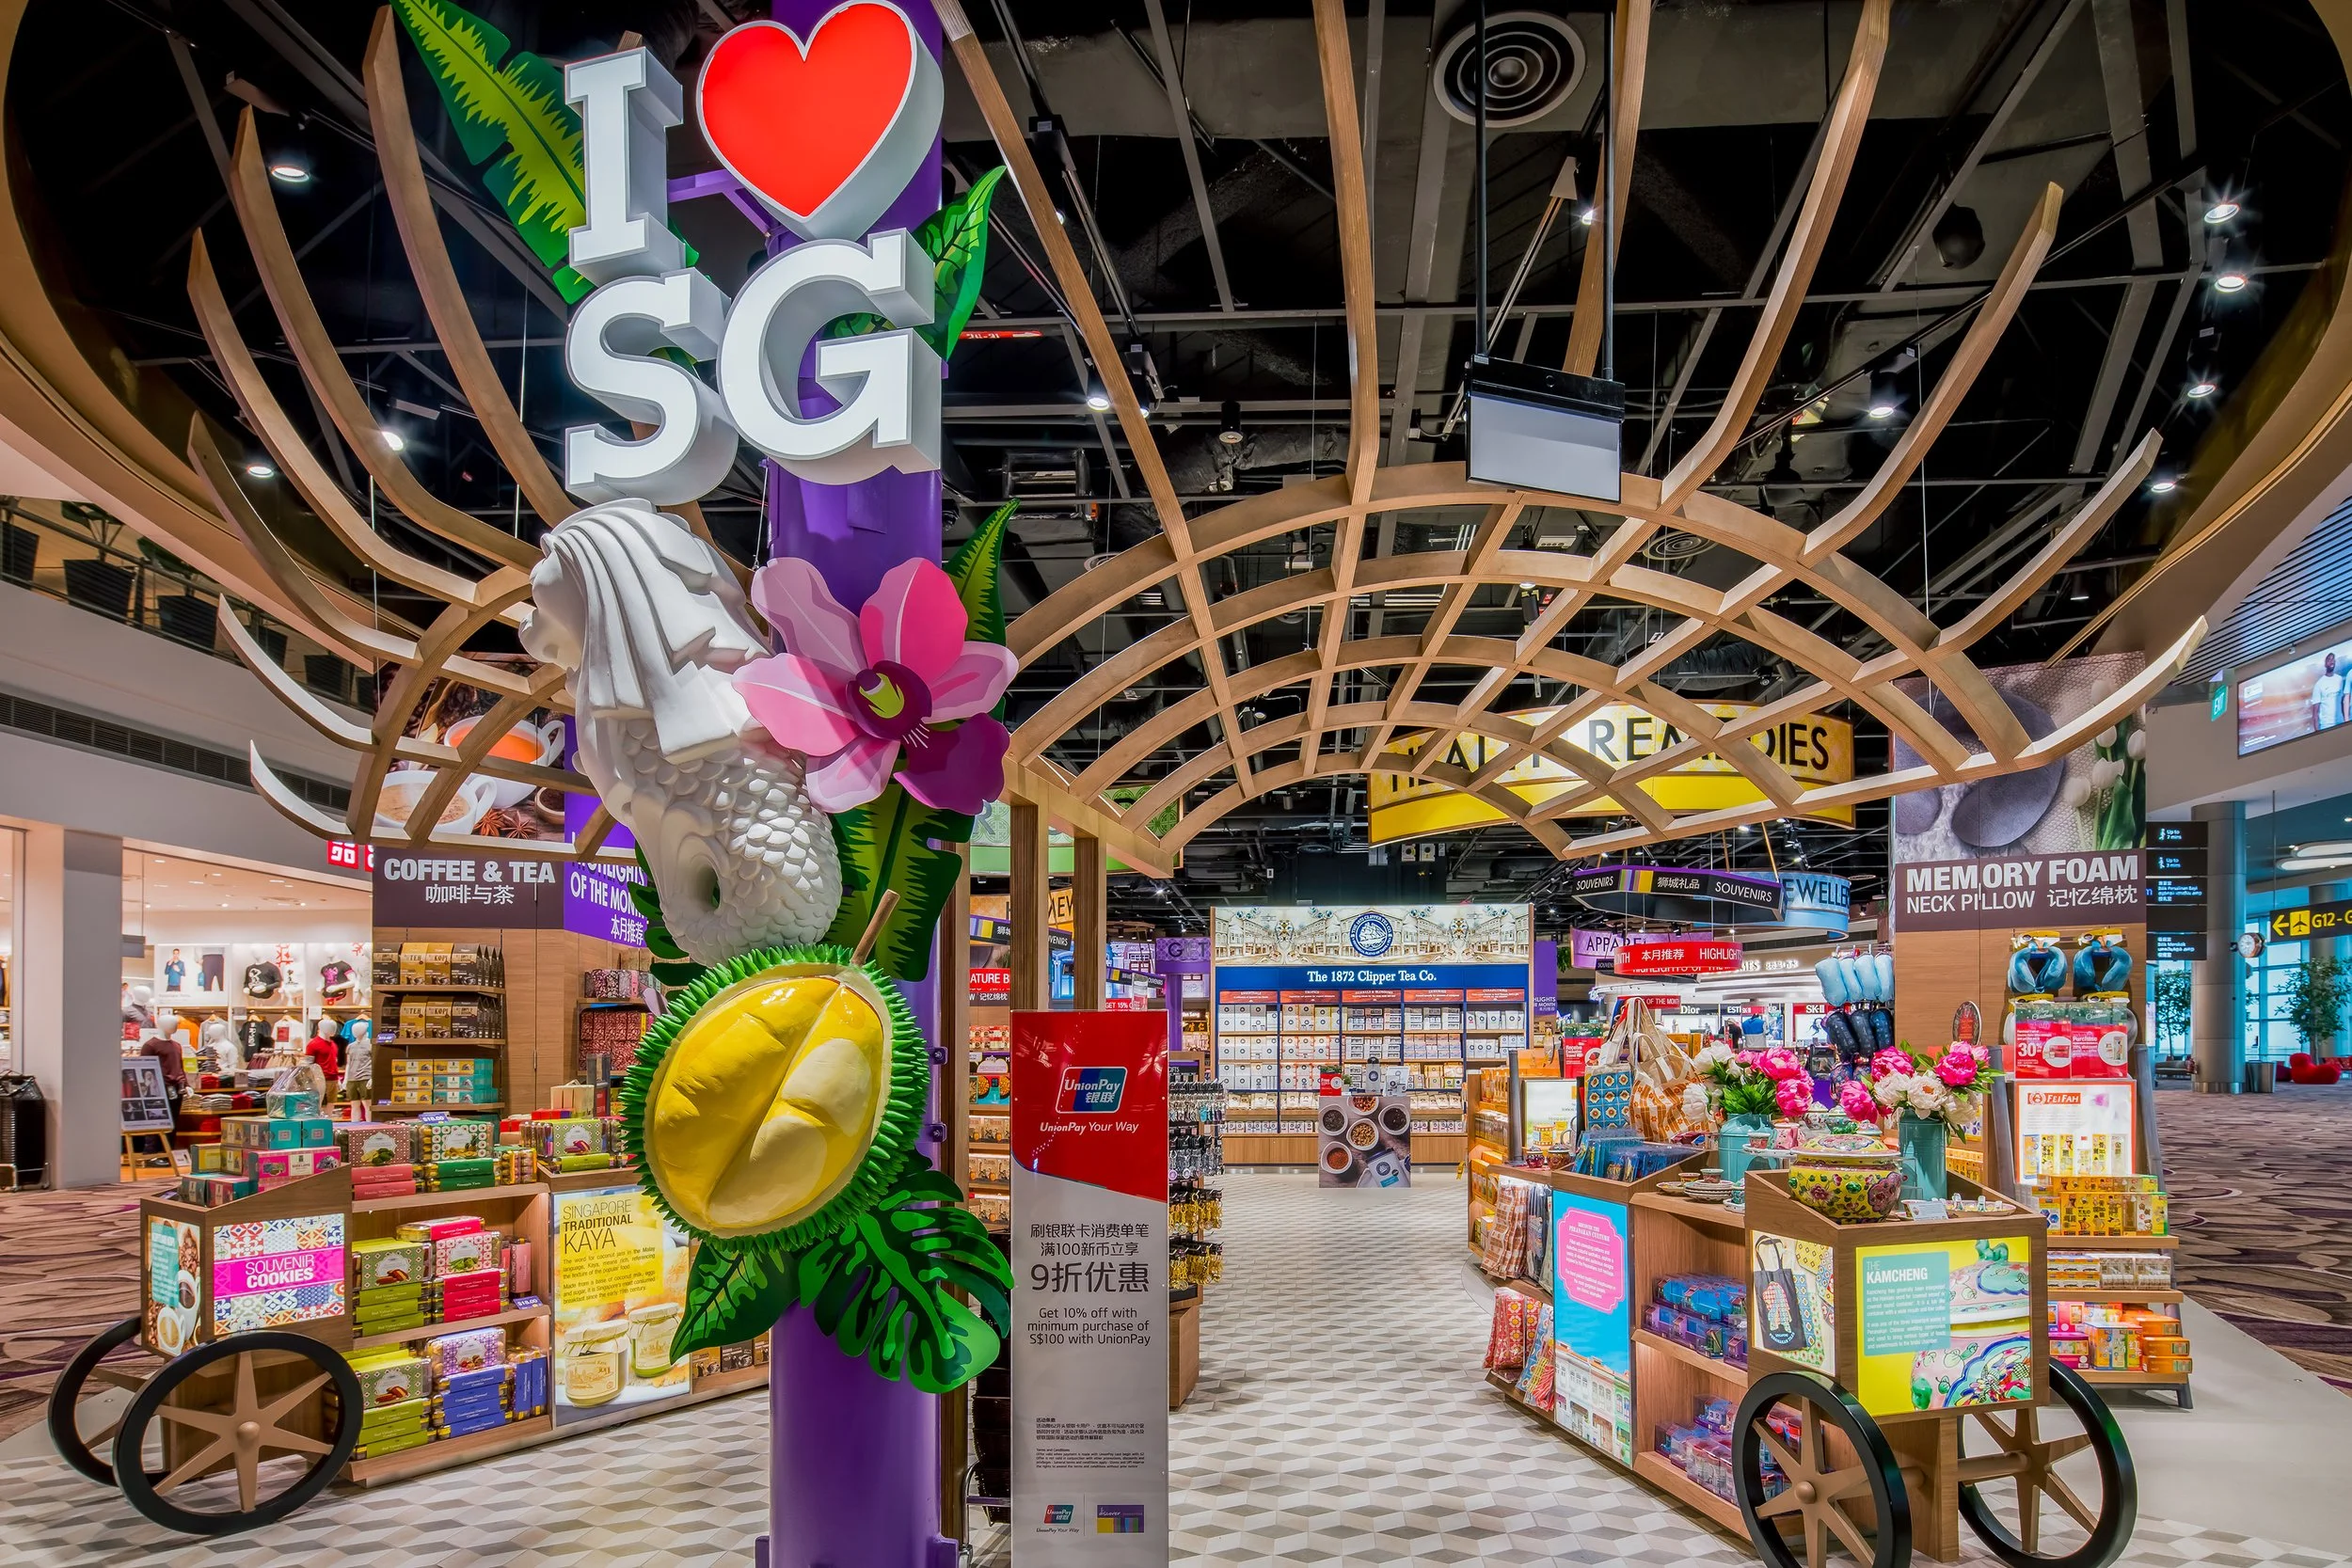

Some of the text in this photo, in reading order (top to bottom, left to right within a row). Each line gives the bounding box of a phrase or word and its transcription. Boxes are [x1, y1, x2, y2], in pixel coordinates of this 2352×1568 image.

[564, 47, 659, 273] I
[565, 229, 927, 500] SG
[383, 857, 556, 884] COFFEE & TEA
[1905, 854, 2139, 893] MEMORY FOAM
[570, 871, 588, 899] OF
[589, 877, 609, 908] THE
[1575, 875, 1614, 892] SOUVENIRS
[1656, 876, 1701, 890] 狮城礼品
[1714, 880, 1773, 903] SOUVENIRS
[425, 883, 516, 905] 咖啡与茶
[1905, 883, 2139, 914] NECK PILLOW 记忆绵枕
[2312, 911, 2336, 928] G12
[1641, 948, 1685, 961] 本月推荐
[1307, 970, 1438, 986] The 1872 Clipper Tea Co.
[1680, 1006, 1701, 1015] Dior
[1805, 1005, 1825, 1015] SK-II
[1064, 1079, 1120, 1095] UnionPay
[1085, 1091, 1116, 1103] 银联
[1040, 1121, 1139, 1135] UnionPay Your Way
[562, 1198, 631, 1222] SINGAPORE
[562, 1214, 633, 1233] TRADITIONAL
[1030, 1223, 1150, 1239] 刷银联卡消费单笔
[564, 1227, 617, 1256] KAYA
[1041, 1242, 1139, 1257] 满100新币立享
[245, 1254, 315, 1275] SOUVENIR
[1867, 1260, 1881, 1271] THE
[246, 1266, 315, 1290] COOKIES
[1030, 1261, 1150, 1293] 9折优惠
[1867, 1267, 1929, 1285] KAMCHENG
[1039, 1307, 1137, 1319] Get 10% off with
[1027, 1320, 1150, 1335] minimum purchase of
[1029, 1333, 1152, 1347] S$100 with UnionPay
[1046, 1508, 1072, 1516] UnionPay
